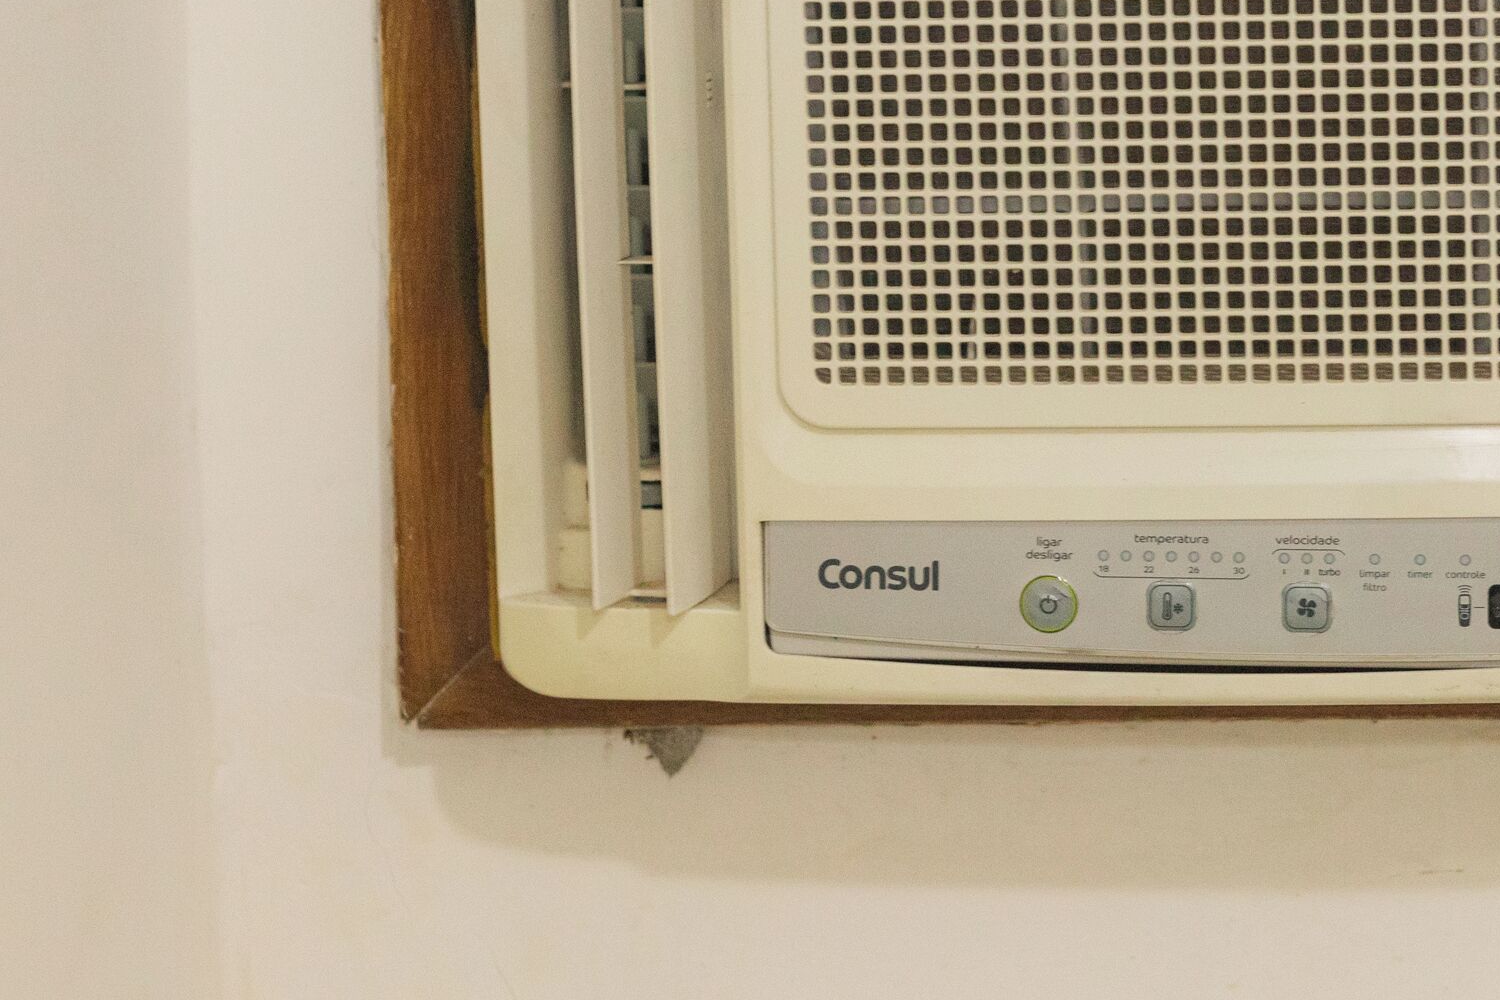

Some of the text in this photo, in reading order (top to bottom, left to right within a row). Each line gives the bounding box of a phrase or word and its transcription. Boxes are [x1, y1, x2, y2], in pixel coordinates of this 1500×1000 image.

[1036, 536, 1063, 549] ligar
[1134, 534, 1209, 545] temperatura
[1275, 535, 1341, 546] velocidade
[1025, 549, 1073, 562] desligar
[818, 558, 939, 591] Consul
[1098, 564, 1246, 575] 18 22 26 30
[1318, 568, 1341, 577] turbo
[1359, 569, 1391, 580] limpar
[1407, 570, 1433, 579] timer
[1445, 570, 1486, 580] controle
[1363, 582, 1387, 592] filtro
